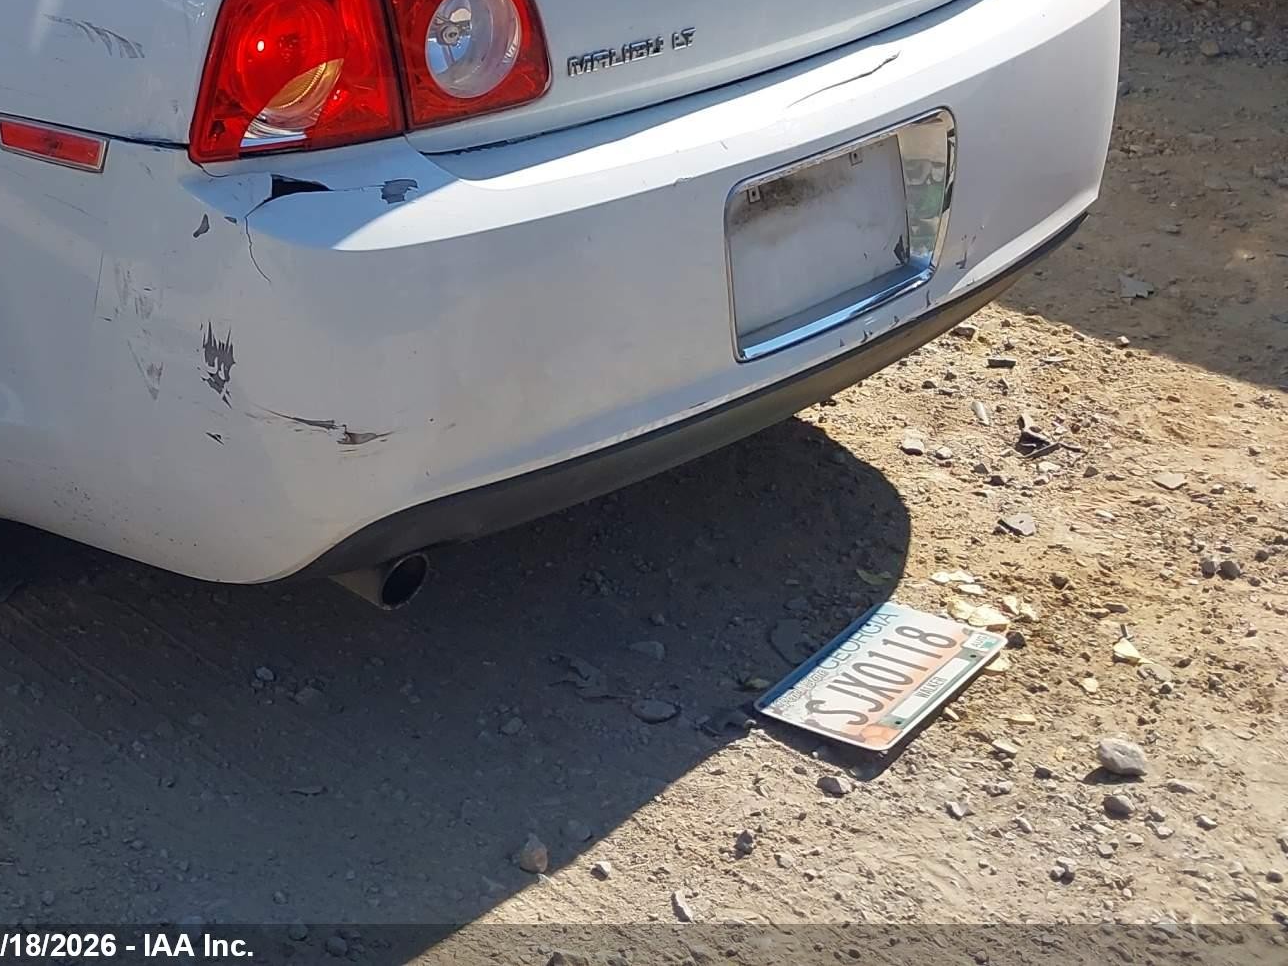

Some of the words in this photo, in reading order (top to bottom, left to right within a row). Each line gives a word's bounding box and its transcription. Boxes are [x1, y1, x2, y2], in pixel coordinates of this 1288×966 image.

[567, 35, 664, 78] MALIBU
[819, 611, 900, 670] GEORGIA
[914, 676, 949, 699] WALKER
